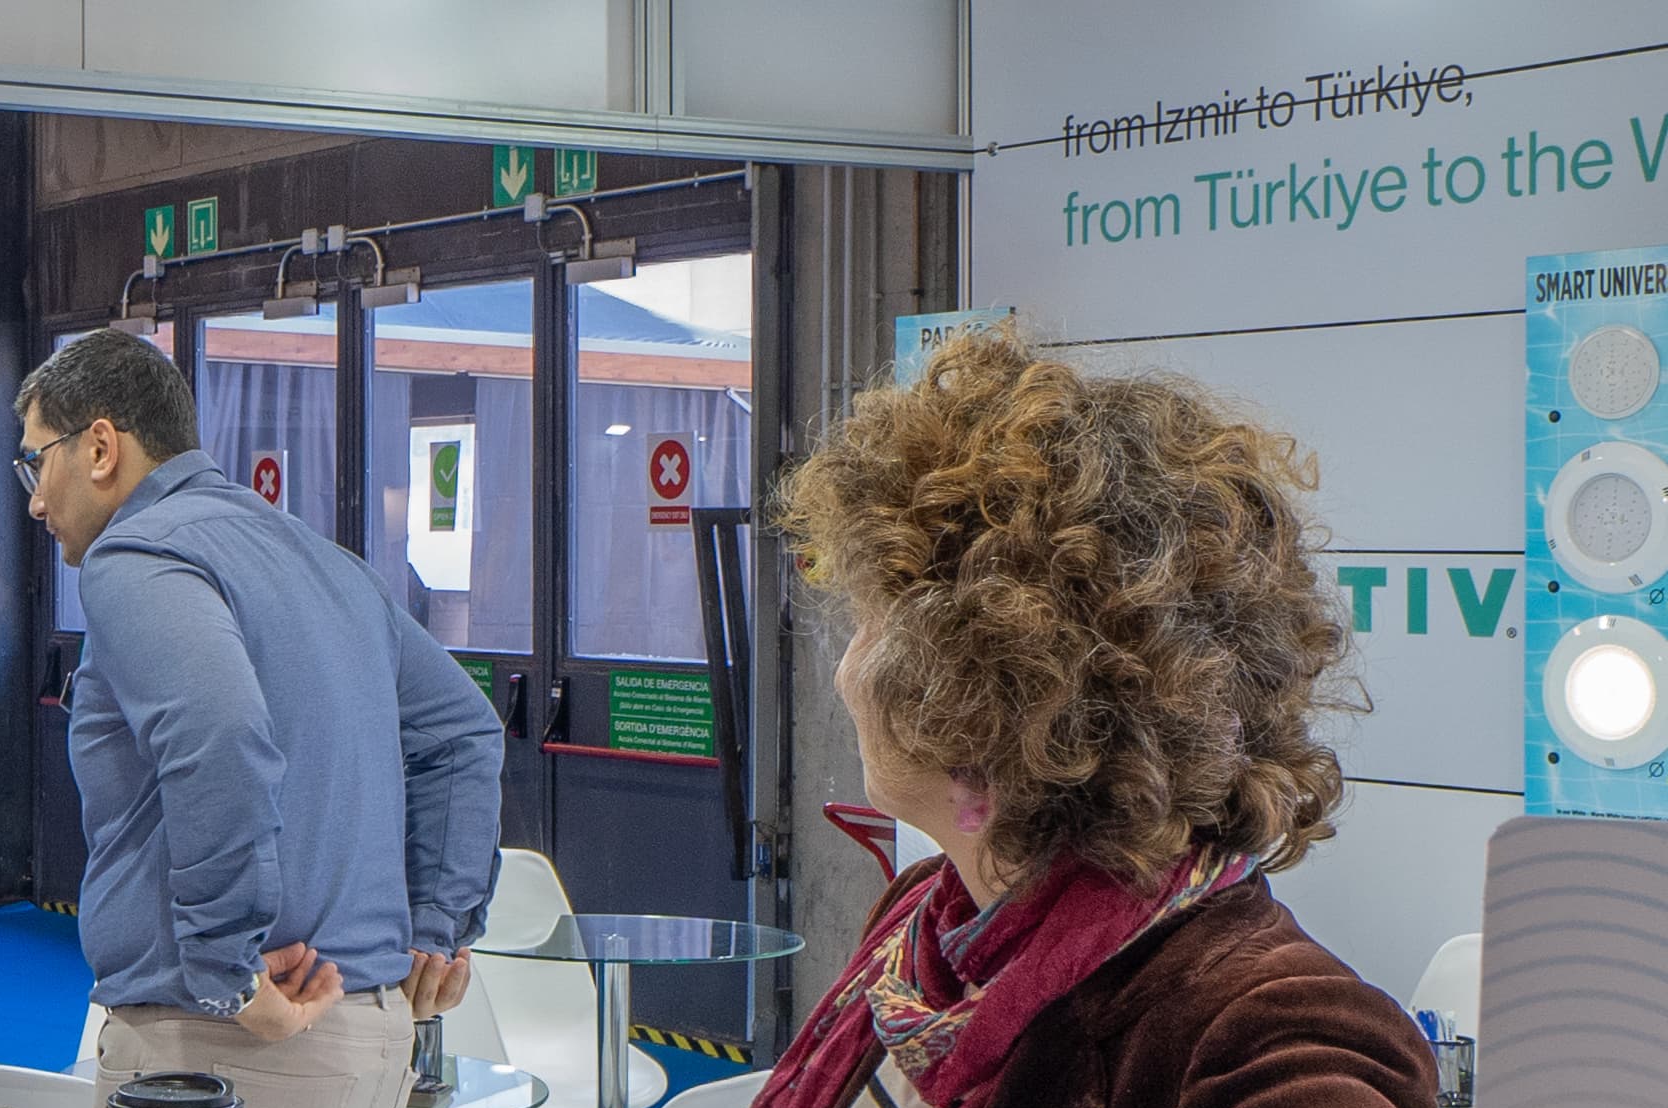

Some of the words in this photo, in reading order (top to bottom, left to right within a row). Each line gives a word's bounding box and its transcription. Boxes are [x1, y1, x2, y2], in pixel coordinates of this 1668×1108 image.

[1063, 112, 1145, 157] from
[1155, 90, 1247, 145] Izmir
[1256, 86, 1294, 130] to
[1305, 61, 1474, 118] Türkiye,
[1063, 190, 1181, 247] from
[1194, 158, 1407, 232] Türkiye
[1423, 146, 1486, 207] to
[1501, 130, 1613, 198] the
[1535, 269, 1596, 303] SMART
[1600, 263, 1668, 297] UNIVER
[615, 676, 642, 687] SALIDA
[644, 677, 655, 688] DE
[656, 679, 709, 692] EMERGENCIA
[614, 720, 648, 733] SORTIDA
